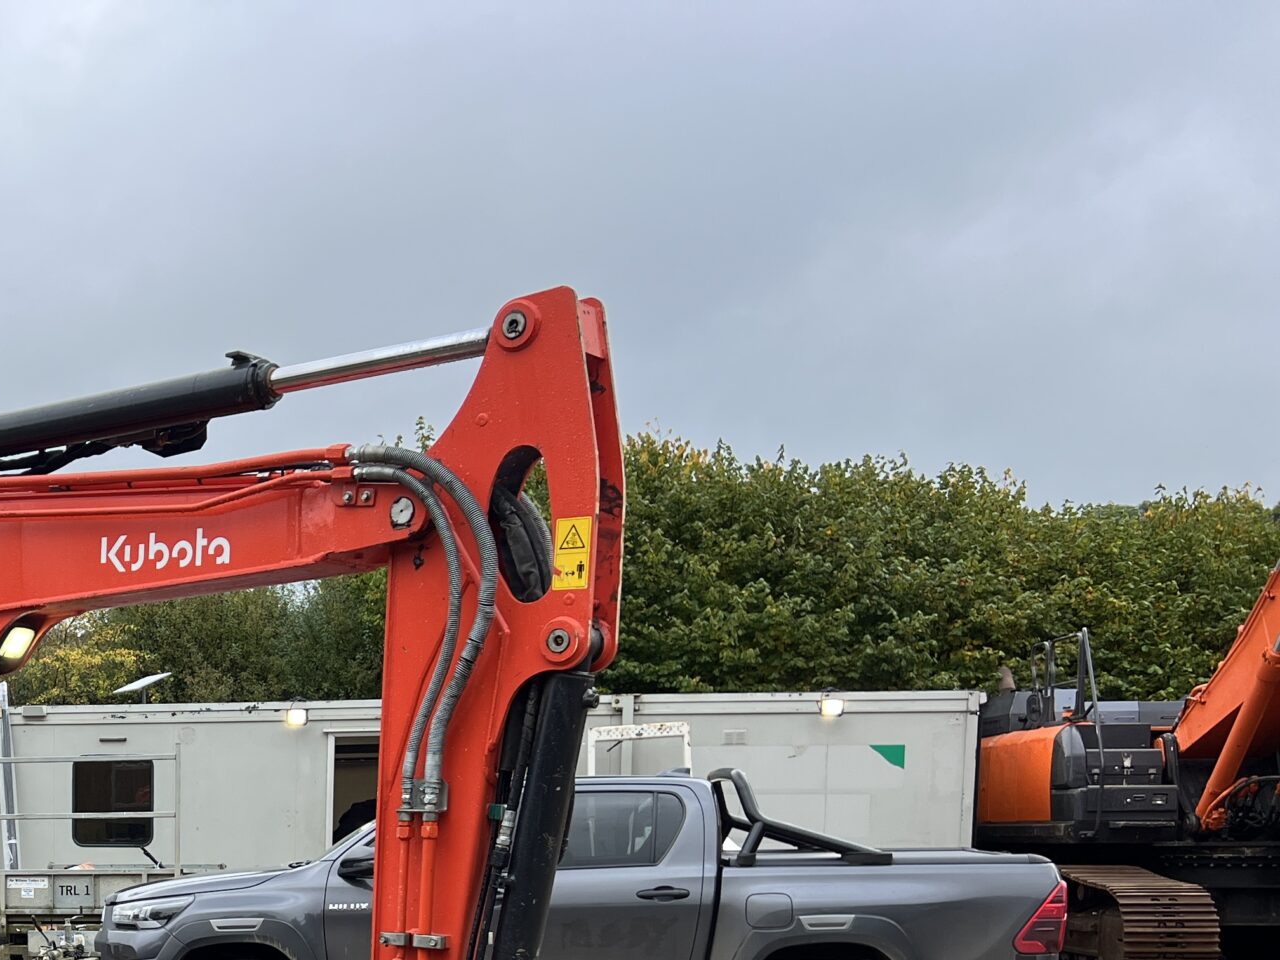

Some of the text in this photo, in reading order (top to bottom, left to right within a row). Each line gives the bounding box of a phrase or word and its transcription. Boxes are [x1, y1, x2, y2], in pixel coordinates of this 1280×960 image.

[100, 527, 231, 573] Kubota
[59, 885, 91, 896] TRL 1
